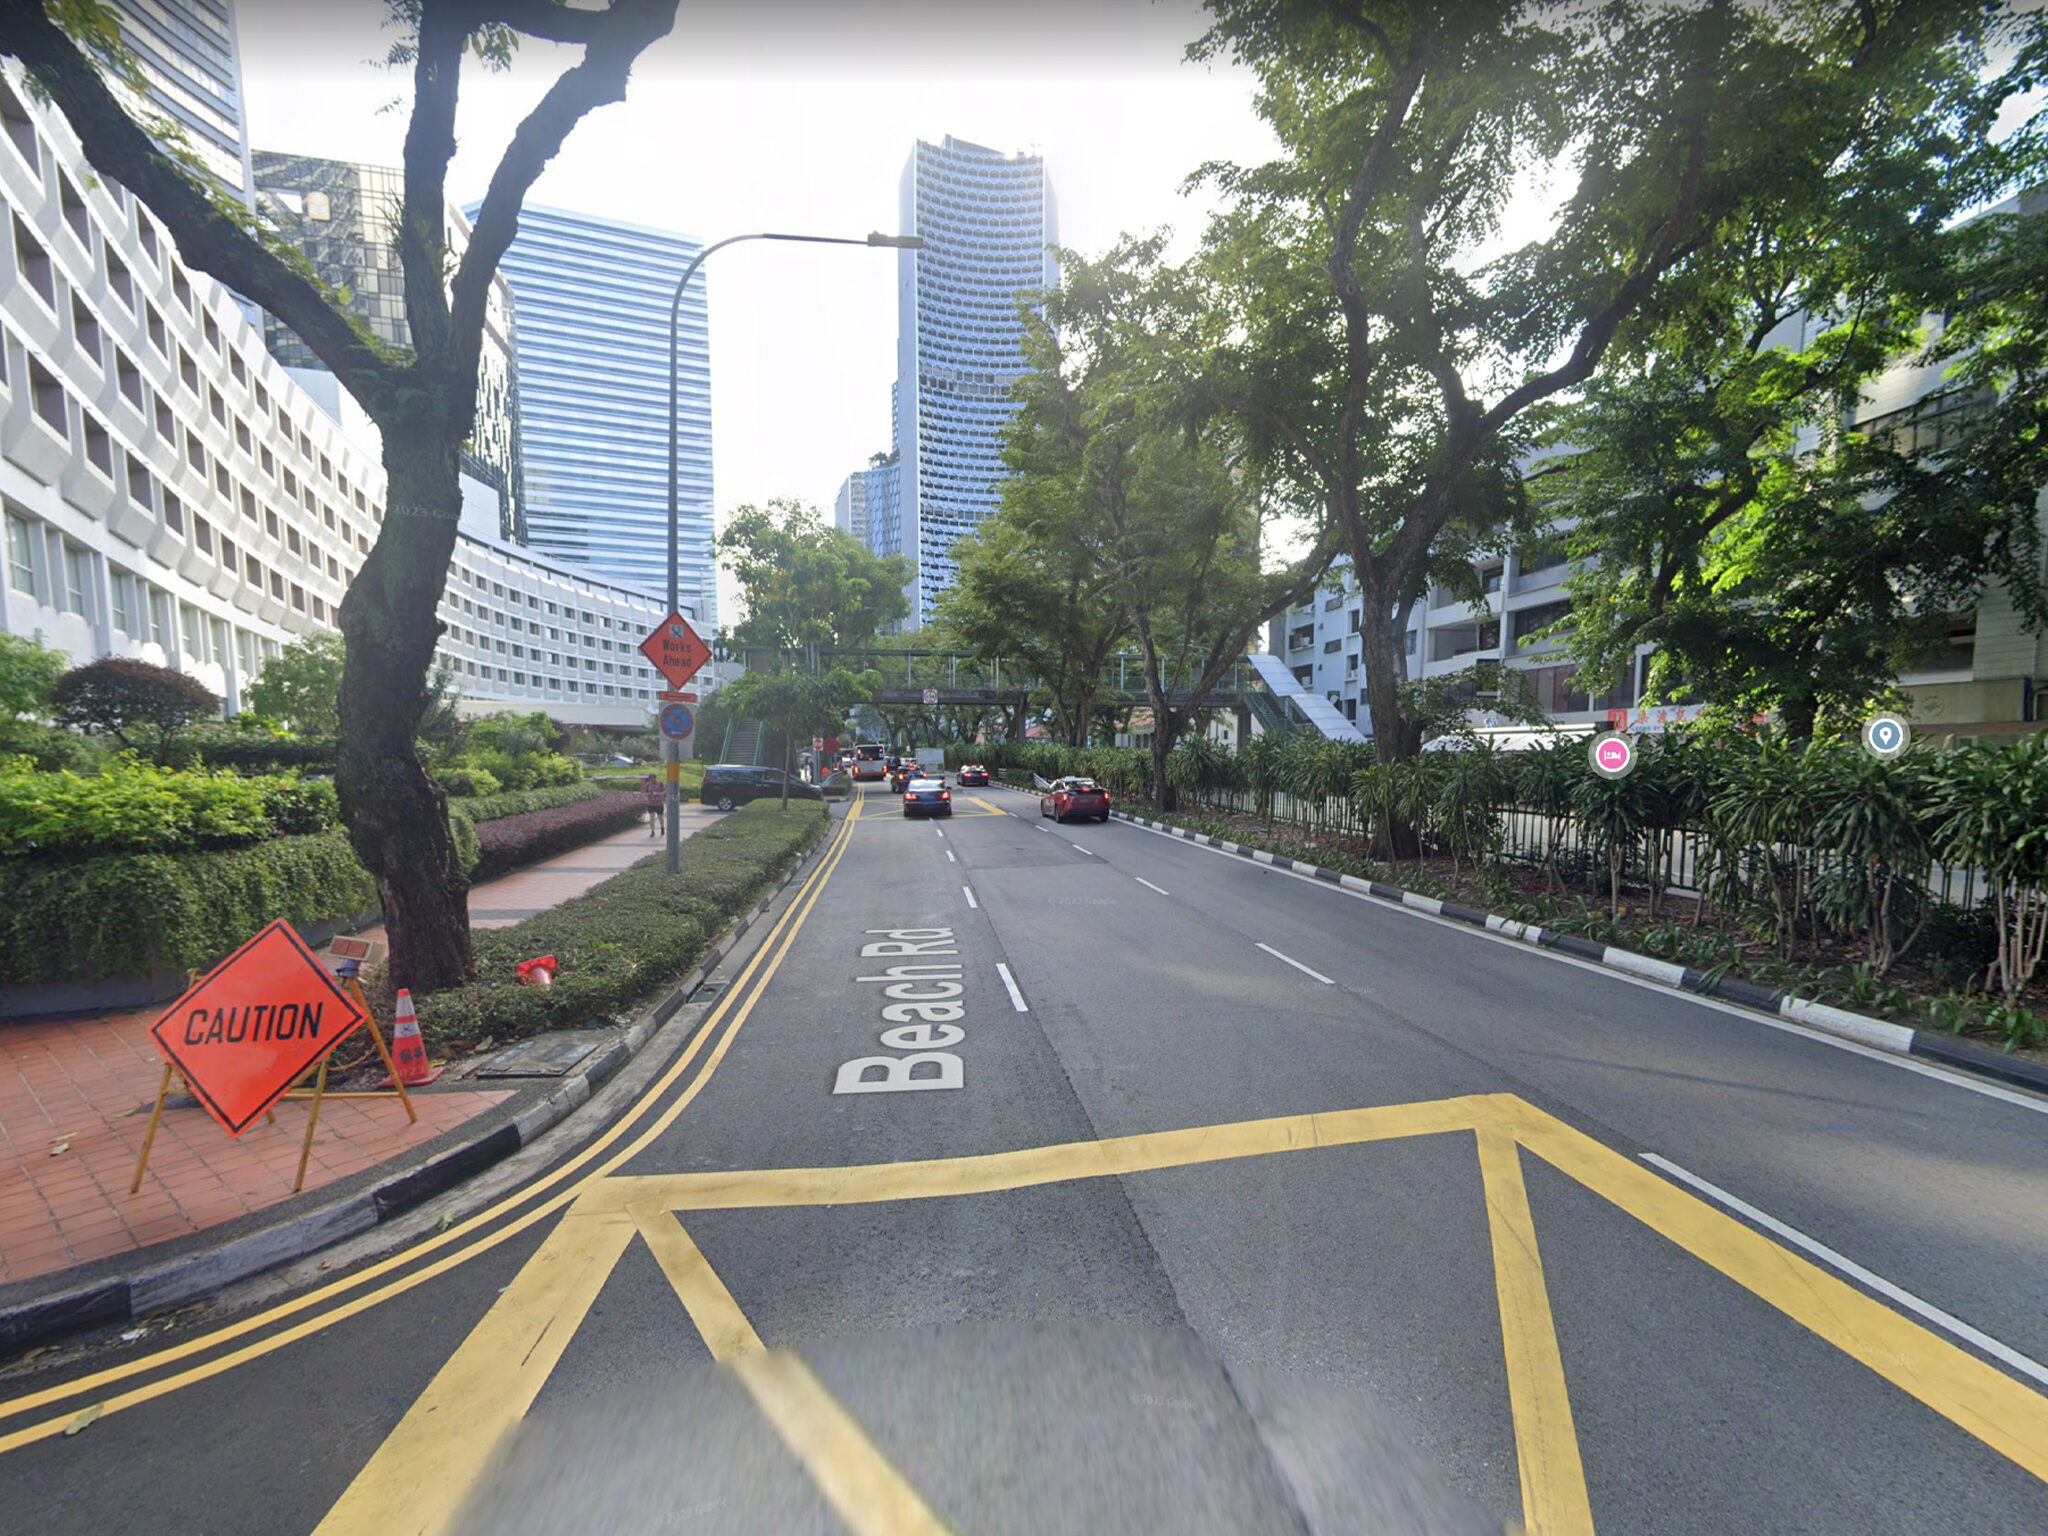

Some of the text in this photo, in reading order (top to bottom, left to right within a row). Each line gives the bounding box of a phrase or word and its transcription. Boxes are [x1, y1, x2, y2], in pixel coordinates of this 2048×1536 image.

[662, 640, 692, 653] Works
[663, 654, 692, 667] Ahead
[184, 1002, 323, 1046] CAUTION
[832, 927, 966, 1095] Beach Rd
